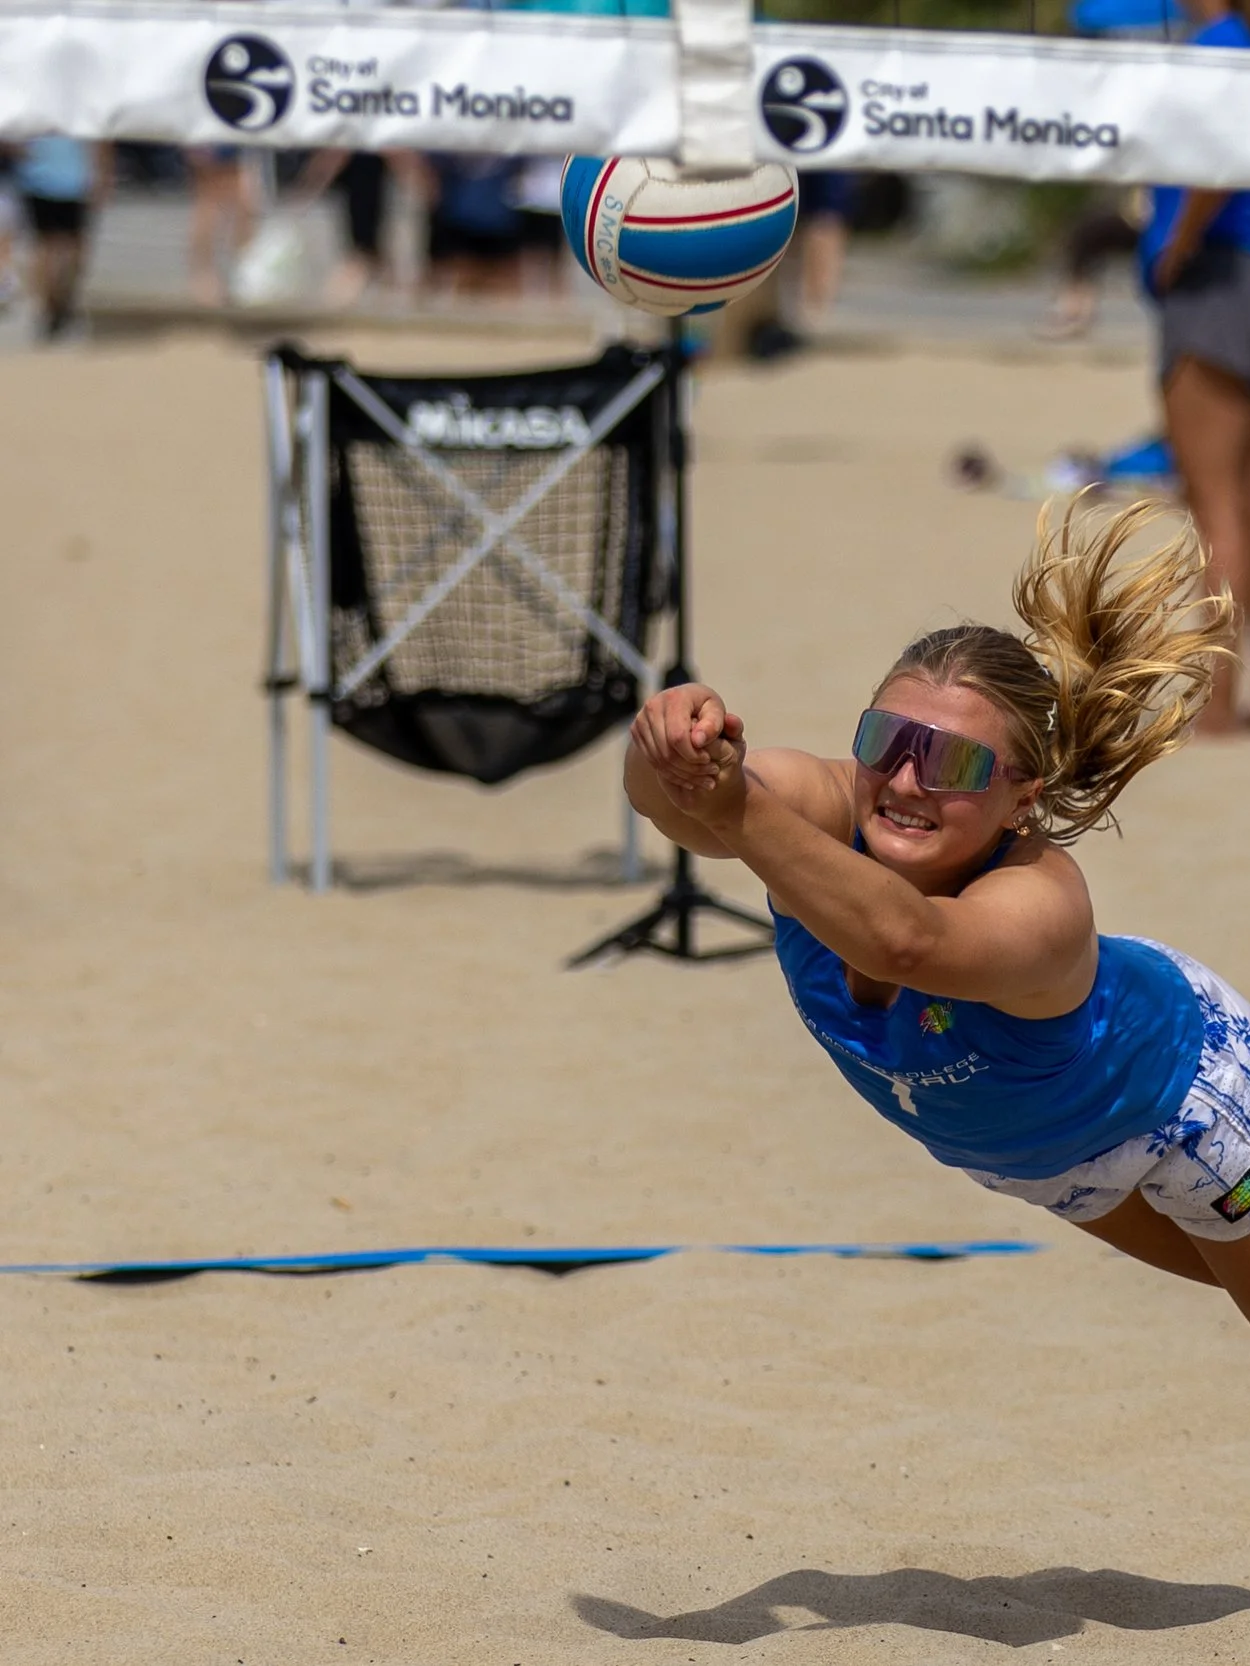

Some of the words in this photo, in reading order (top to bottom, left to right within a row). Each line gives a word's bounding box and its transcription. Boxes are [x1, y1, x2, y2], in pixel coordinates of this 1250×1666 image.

[307, 56, 352, 80] City
[357, 57, 378, 76] of
[860, 79, 903, 101] City
[910, 81, 929, 99] of
[309, 78, 419, 115] Santa
[432, 83, 574, 122] Monica
[863, 101, 973, 140] Santa
[983, 106, 1119, 148] Monica
[597, 194, 624, 254] SMC
